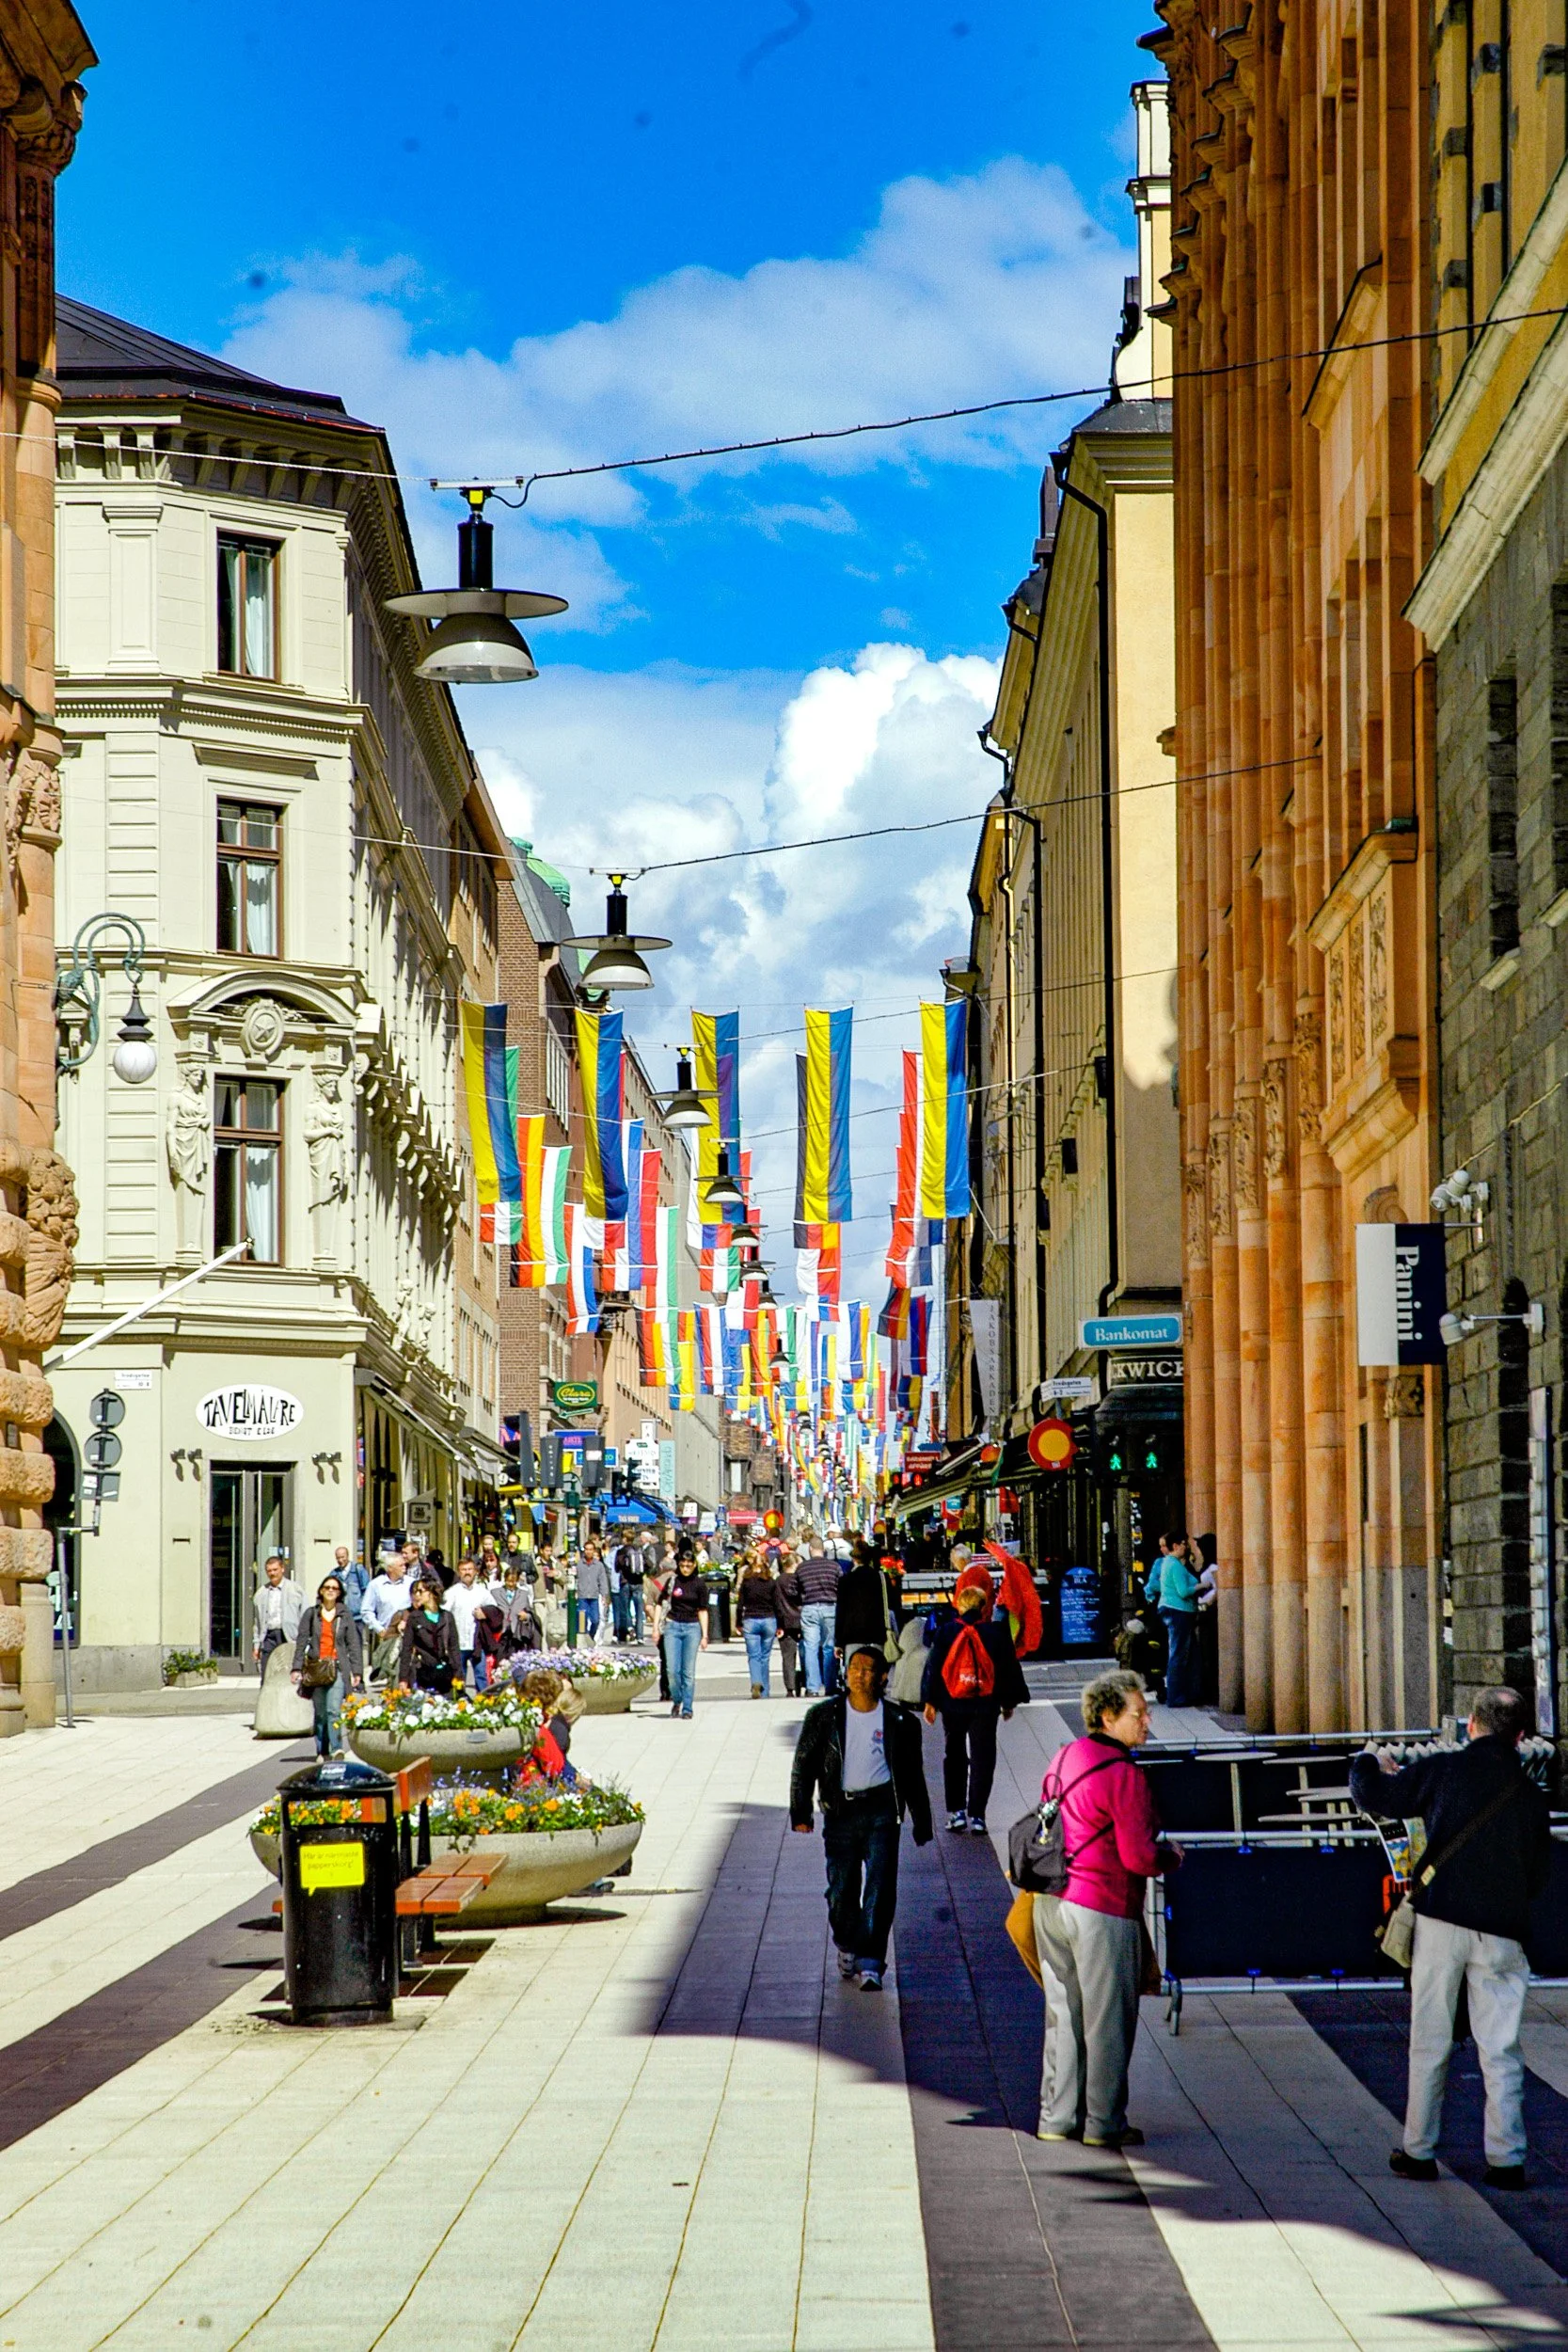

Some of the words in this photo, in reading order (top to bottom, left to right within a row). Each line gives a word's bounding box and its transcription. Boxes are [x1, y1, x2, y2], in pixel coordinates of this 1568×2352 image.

[1396, 1245, 1423, 1341] Panini
[1094, 1327, 1169, 1342] Bankomat
[204, 1389, 295, 1427] TAVELMÅLARE
